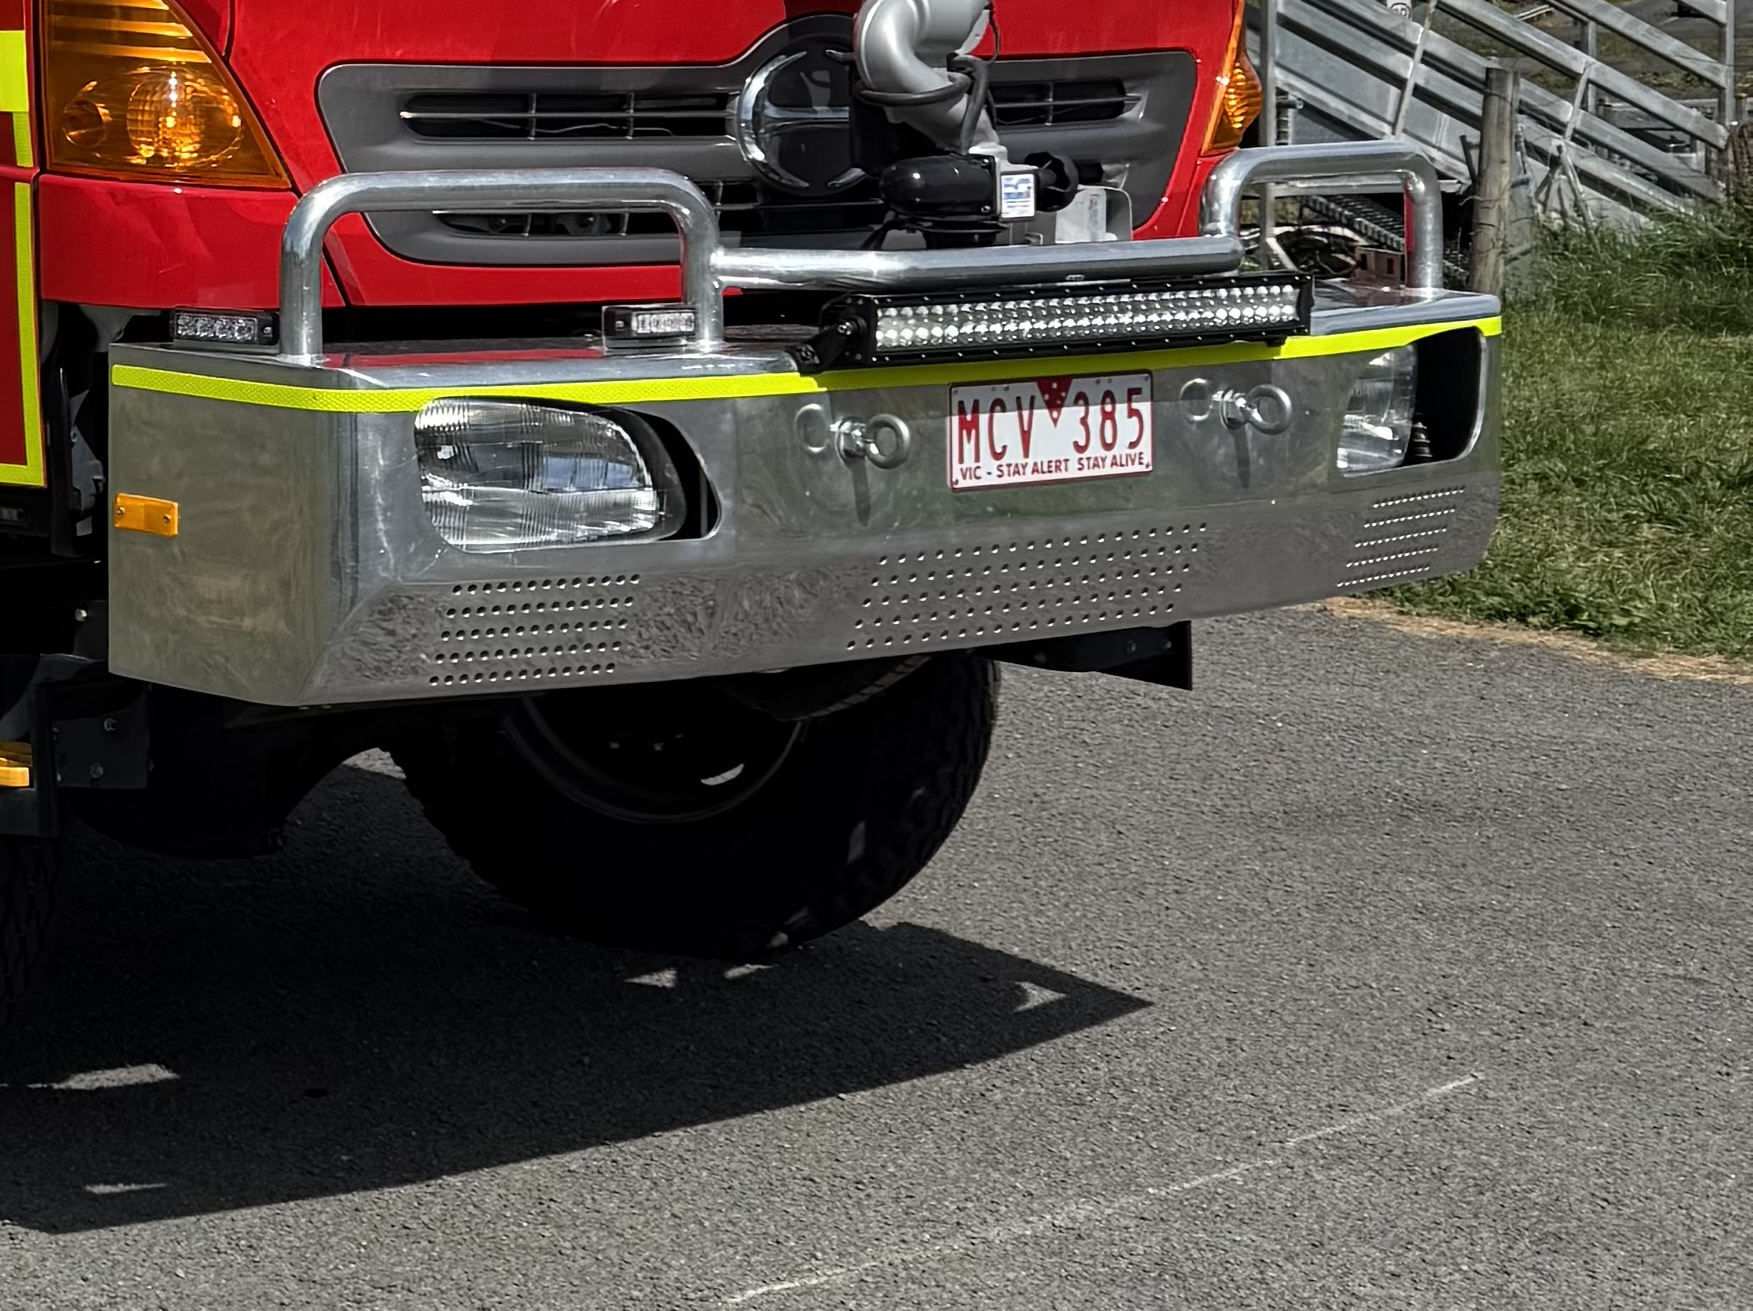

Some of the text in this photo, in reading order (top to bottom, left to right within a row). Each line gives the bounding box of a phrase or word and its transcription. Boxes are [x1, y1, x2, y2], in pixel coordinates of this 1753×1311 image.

[957, 387, 1145, 465] MCV 385
[960, 465, 982, 481] VIC
[996, 462, 1029, 479] STAY
[1031, 458, 1071, 476] ALERT
[1077, 455, 1108, 472] STAY
[1110, 451, 1145, 469] ALIVE
